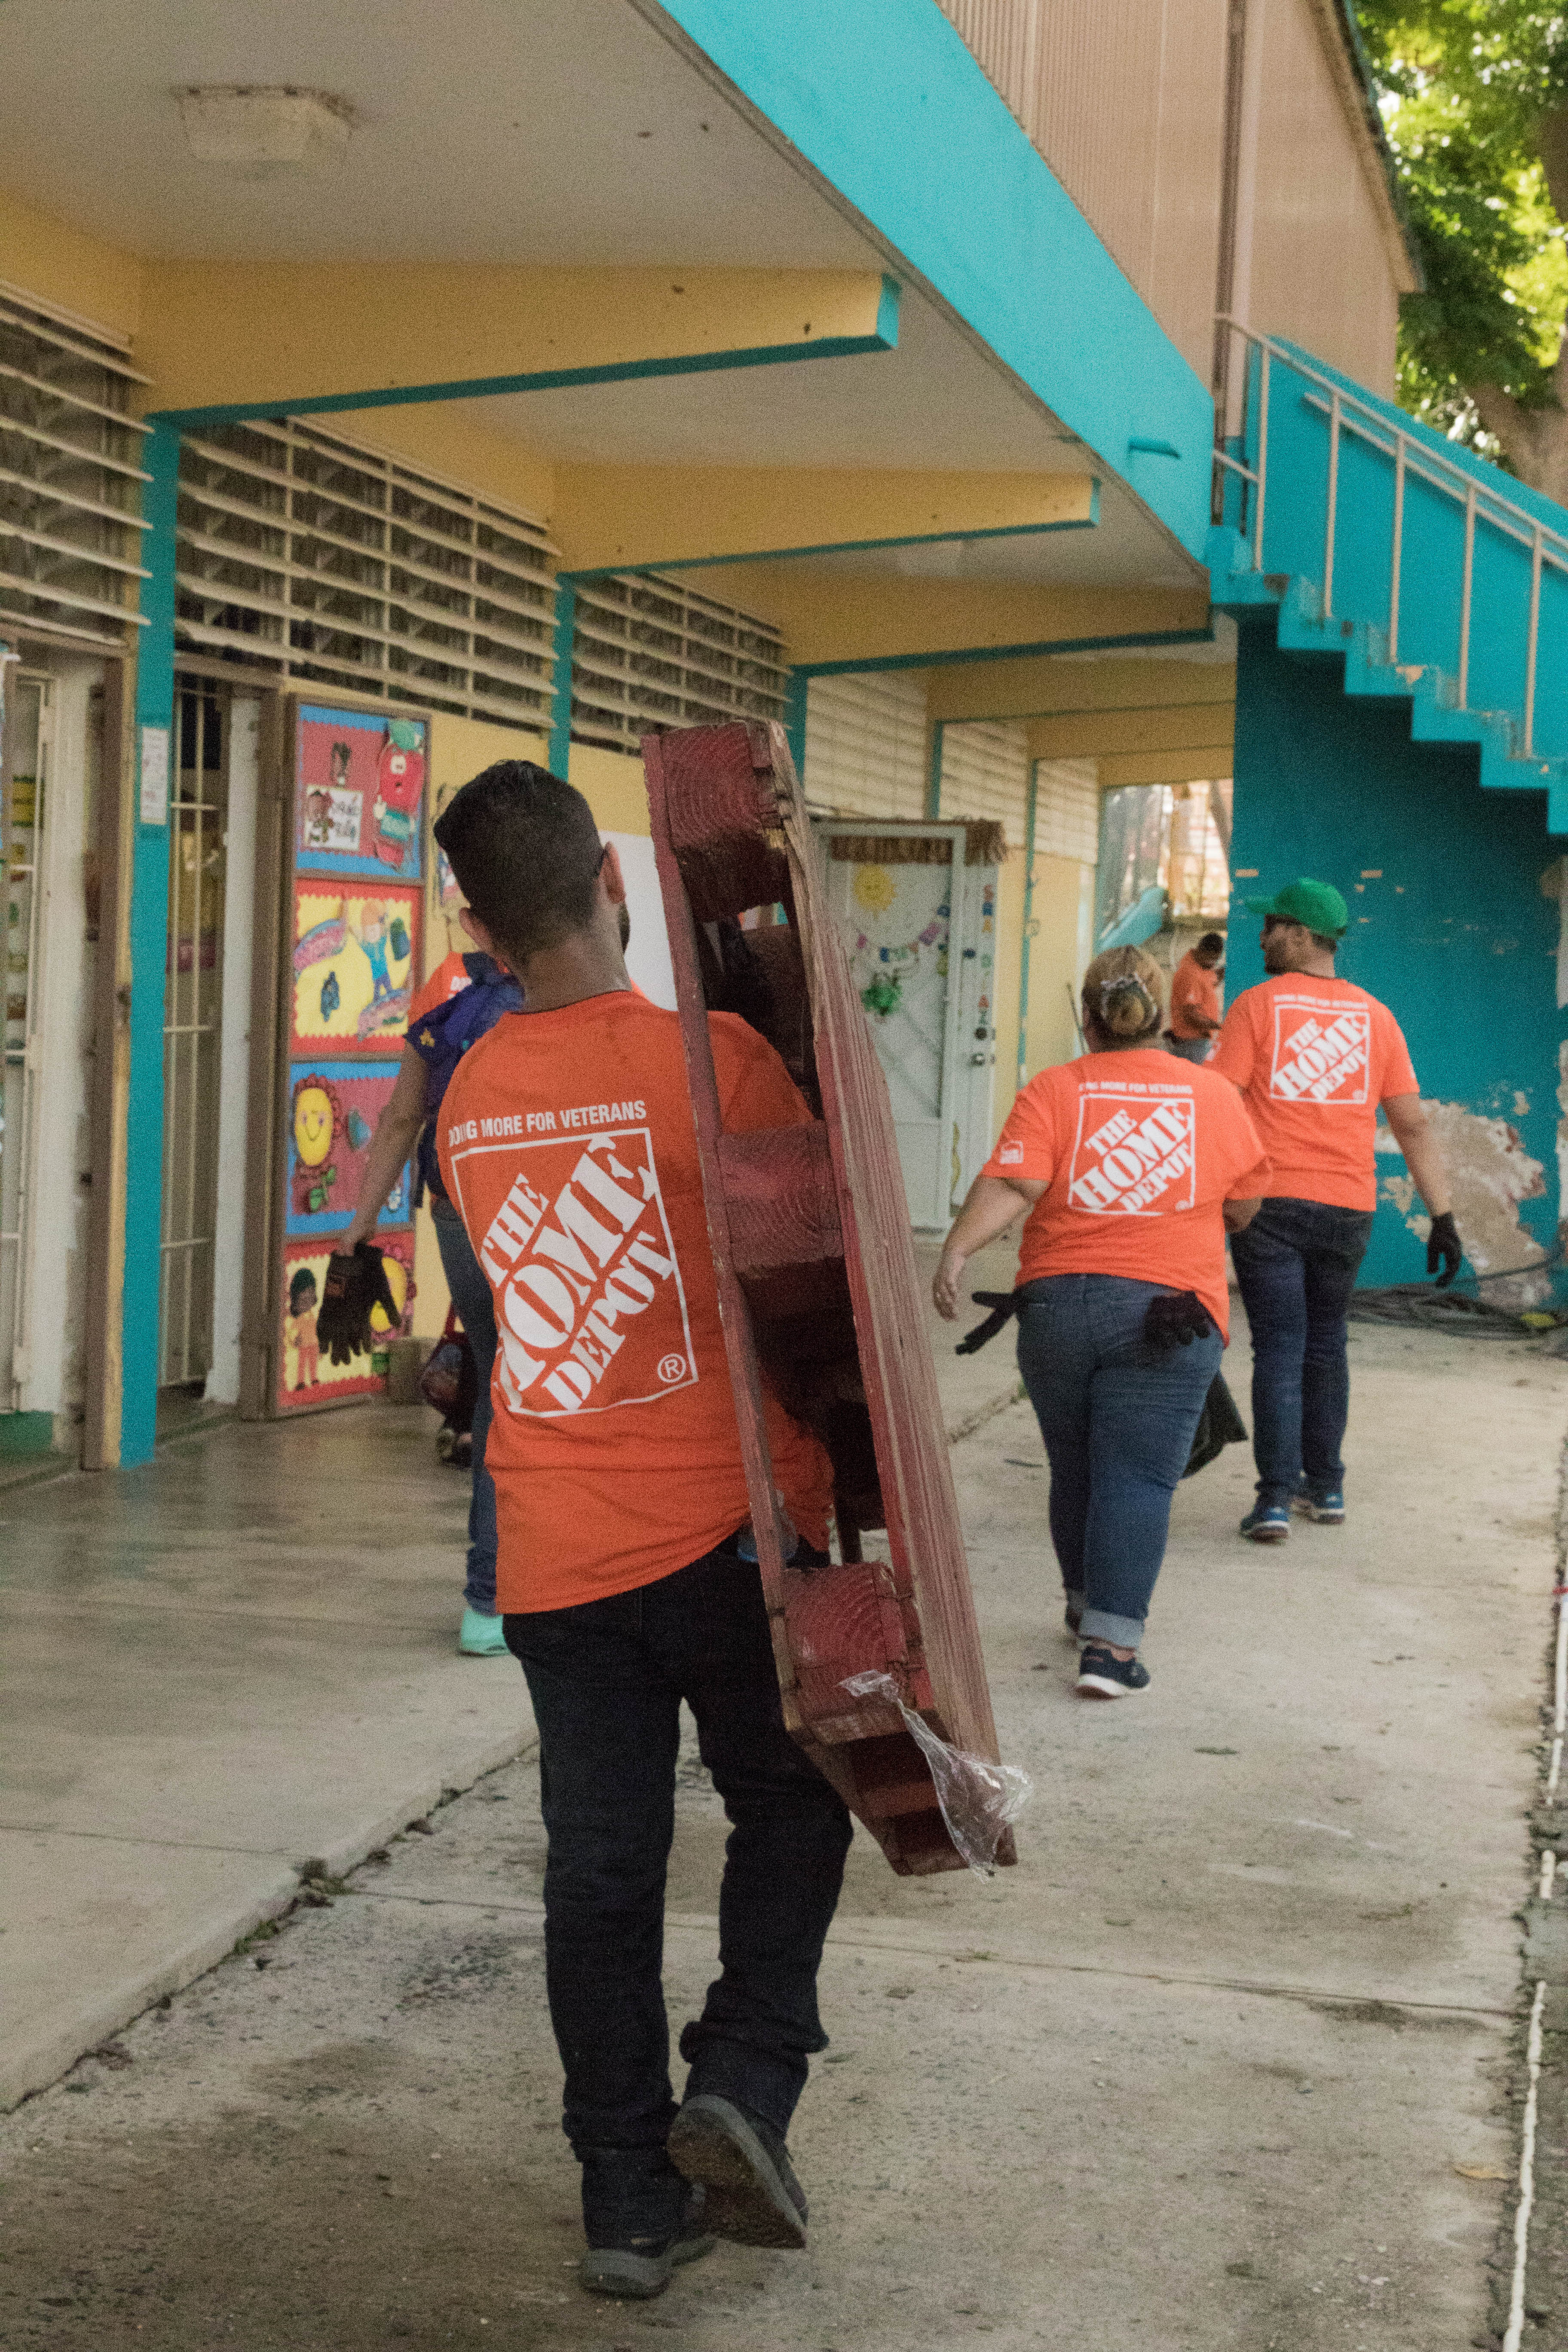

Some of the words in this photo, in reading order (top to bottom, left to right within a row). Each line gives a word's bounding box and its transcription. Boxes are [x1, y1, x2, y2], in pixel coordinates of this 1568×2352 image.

[1272, 1012, 1369, 1099] HOME
[1284, 1018, 1324, 1053] THE
[1310, 1046, 1368, 1101] DEPOT
[480, 1115, 523, 1137] MORE
[526, 1112, 557, 1133] FOR
[560, 1100, 646, 1128] VETERANS
[1084, 1109, 1137, 1156] THE
[1072, 1100, 1192, 1209] HOME
[1119, 1142, 1192, 1213] DEPOT
[481, 1173, 549, 1287] THE
[542, 1230, 674, 1410] DEPOT
